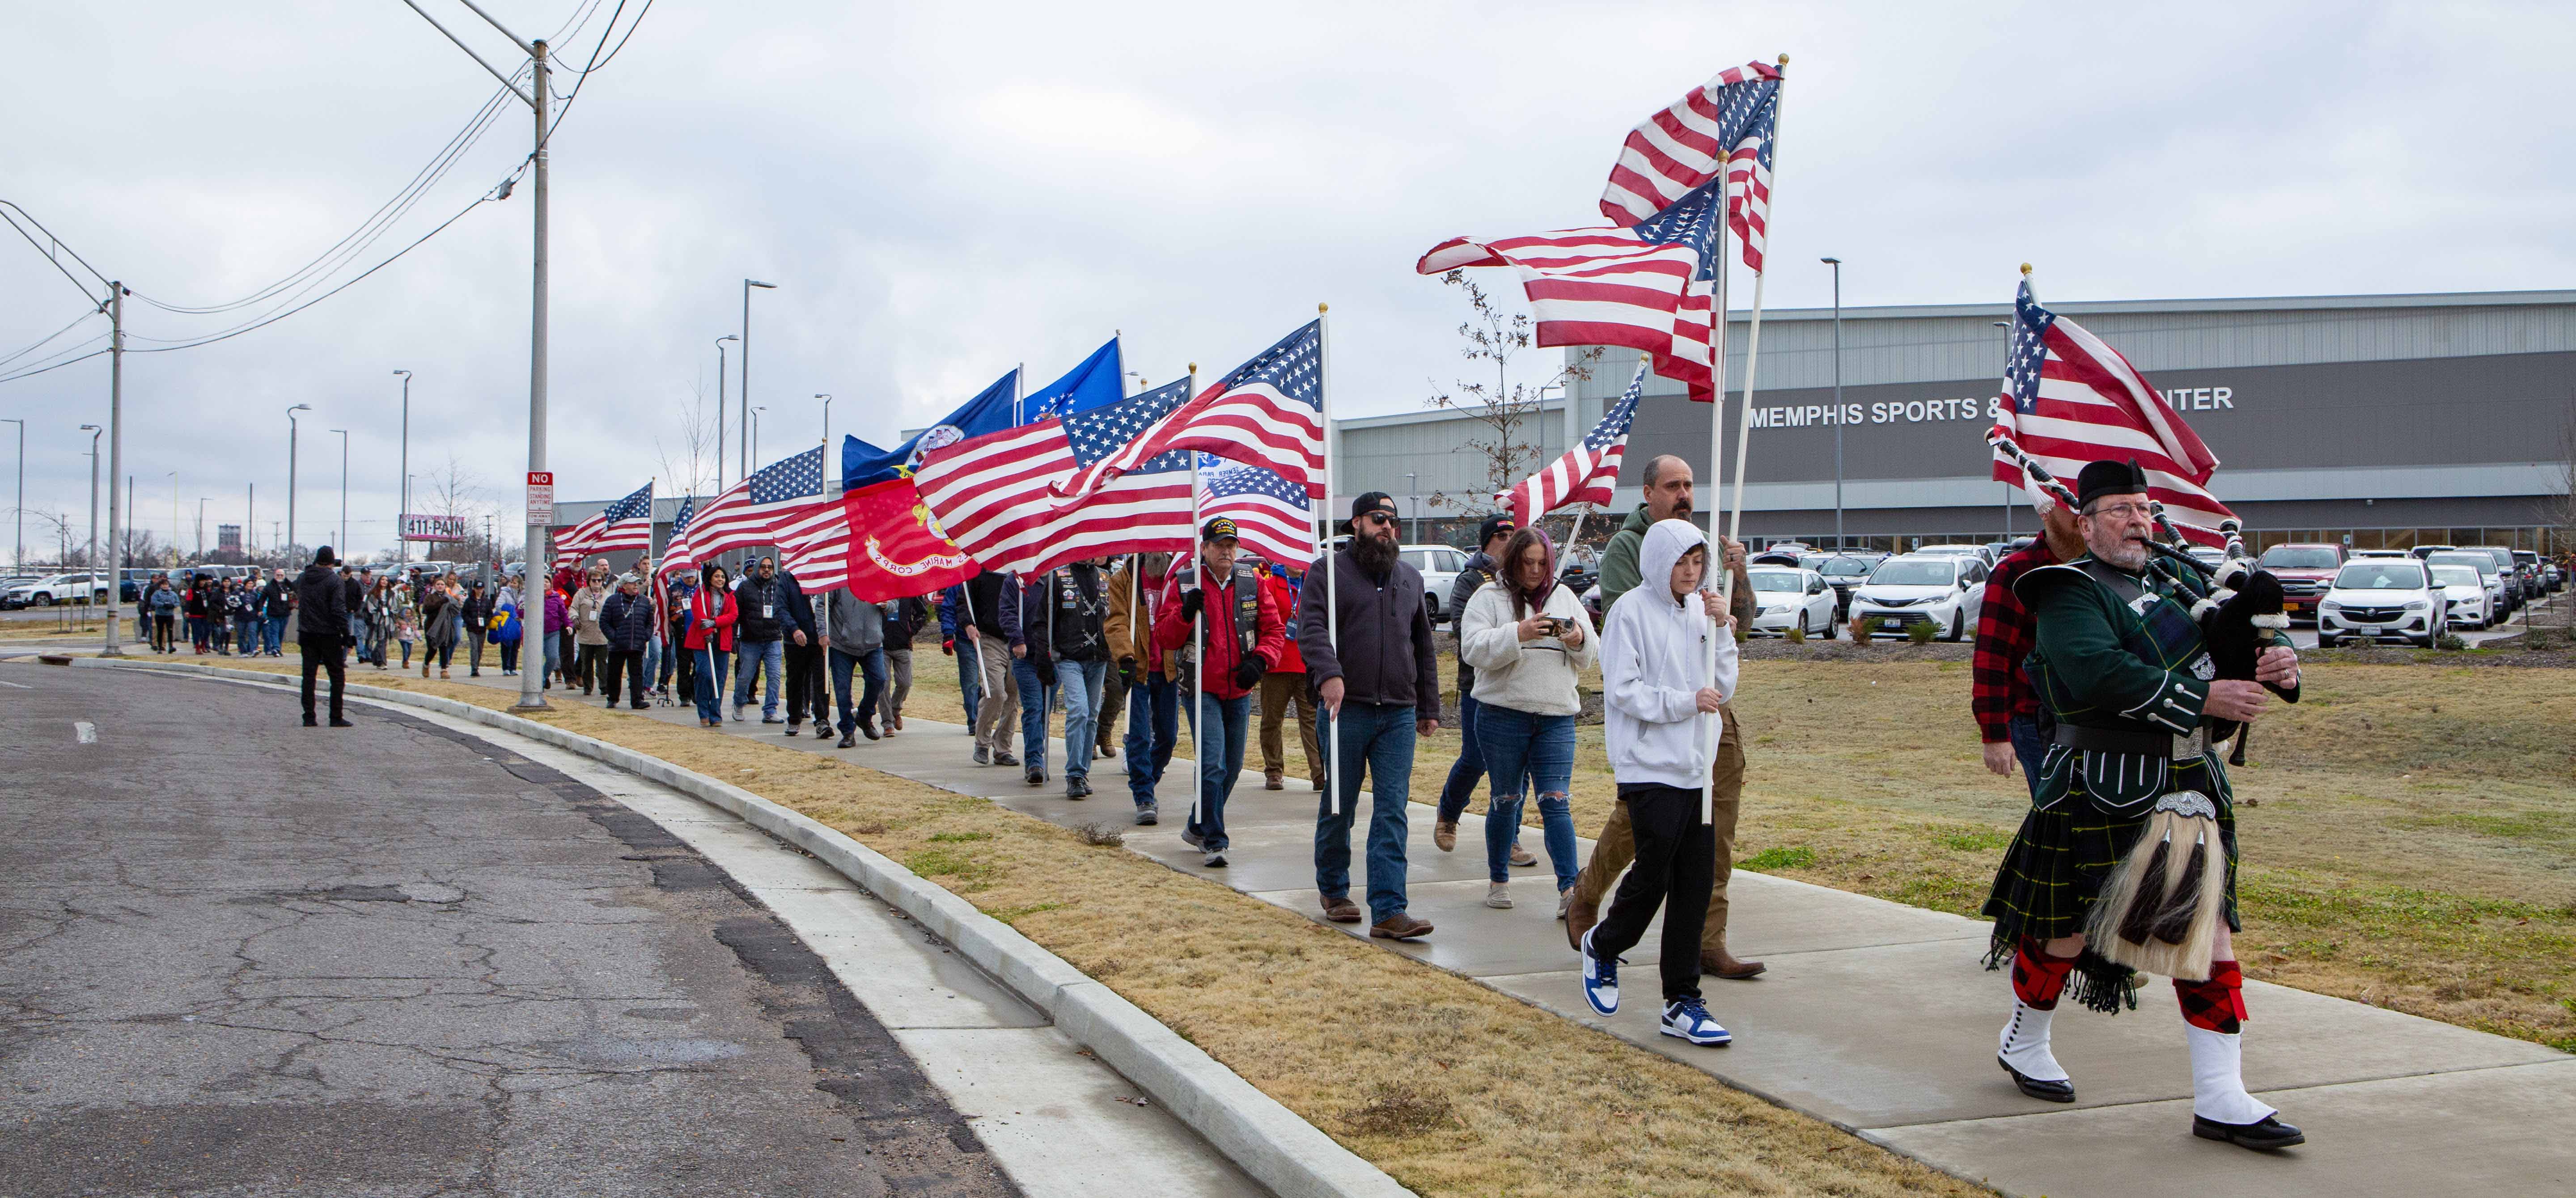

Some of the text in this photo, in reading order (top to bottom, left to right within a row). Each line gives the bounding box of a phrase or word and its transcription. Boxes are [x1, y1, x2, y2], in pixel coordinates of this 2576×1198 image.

[1749, 403, 1864, 428] MEMPHIS
[1871, 398, 1978, 424] SPORTS
[2156, 387, 2234, 410] NTER
[532, 474, 548, 483] NO
